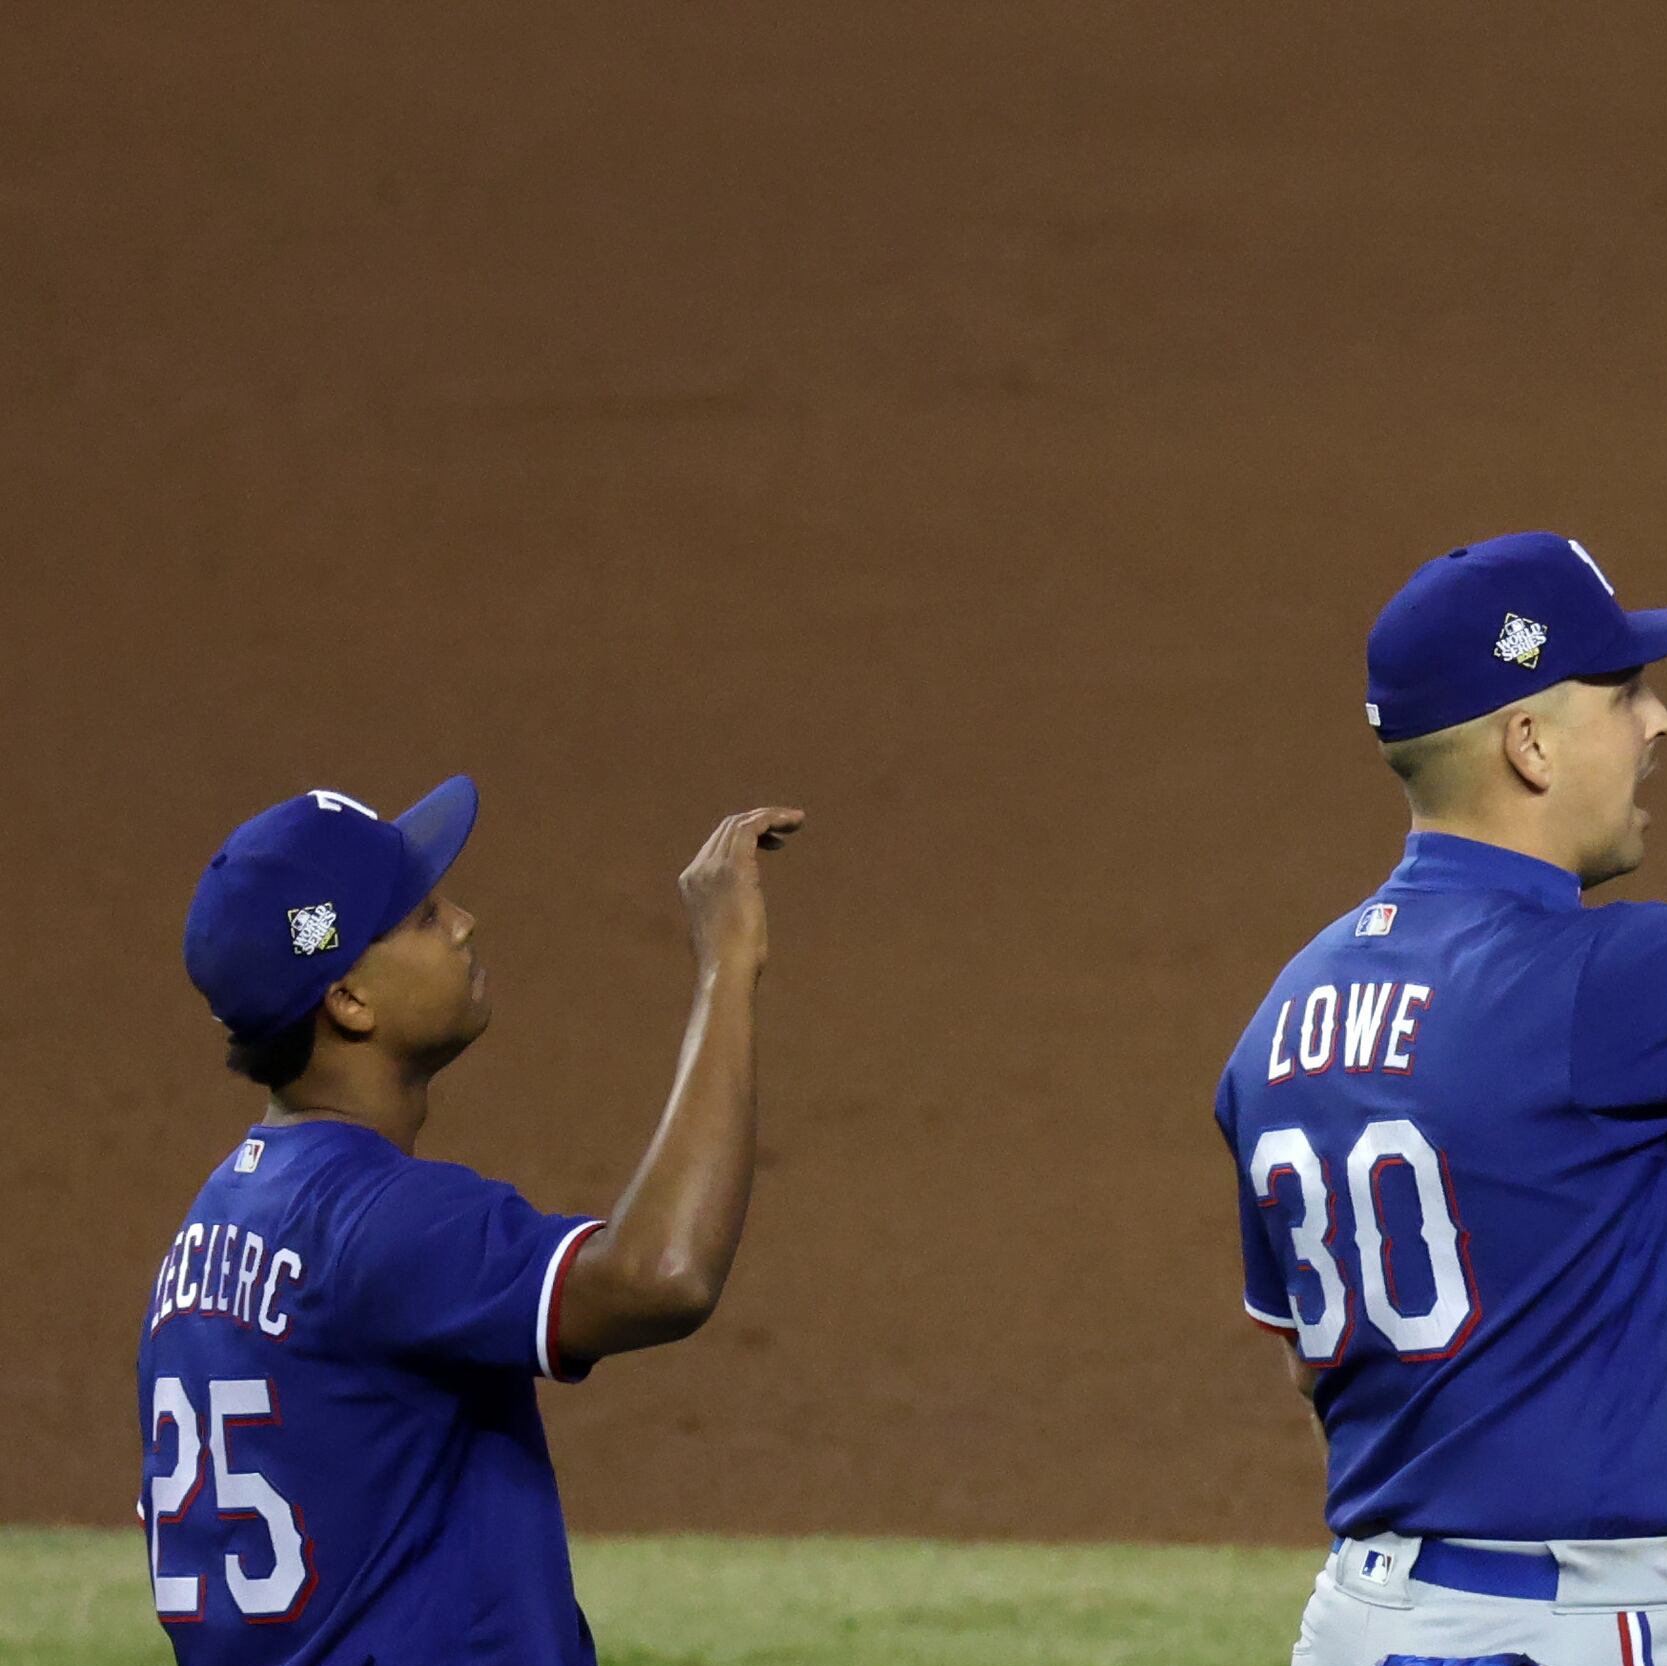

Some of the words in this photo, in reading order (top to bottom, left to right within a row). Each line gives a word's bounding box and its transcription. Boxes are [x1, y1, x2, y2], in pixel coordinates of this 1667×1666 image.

[1495, 622, 1543, 651] WORLD
[1501, 635, 1547, 662] SERIES
[293, 904, 327, 948] WORLD
[302, 909, 338, 956] SERIES
[1267, 982, 1431, 1081] LOWE
[1249, 1118, 1471, 1359] 30
[151, 1376, 306, 1615] 25
